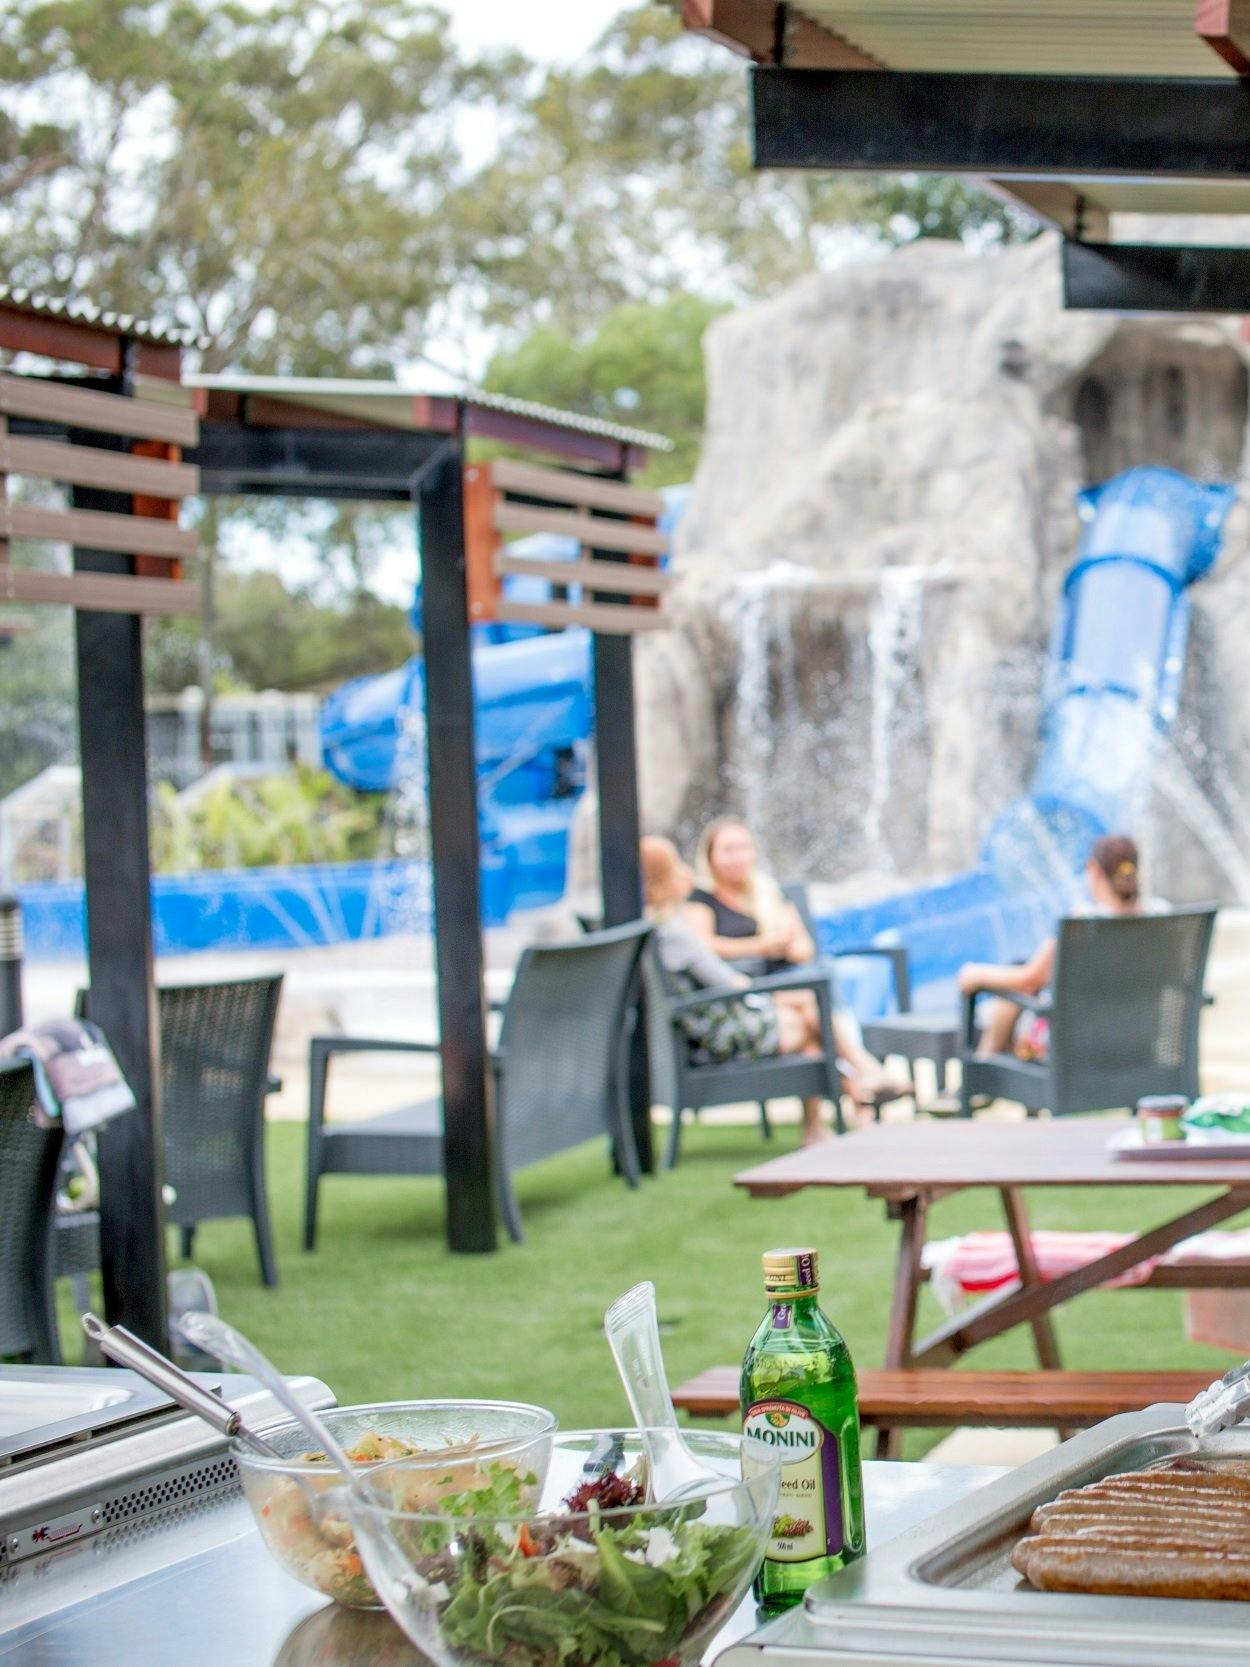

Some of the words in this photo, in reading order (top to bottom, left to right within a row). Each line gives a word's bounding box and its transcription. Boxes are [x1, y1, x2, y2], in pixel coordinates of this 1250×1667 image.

[747, 1427, 815, 1447] MONINI
[780, 1479, 798, 1489] eed
[801, 1479, 816, 1490] Oil
